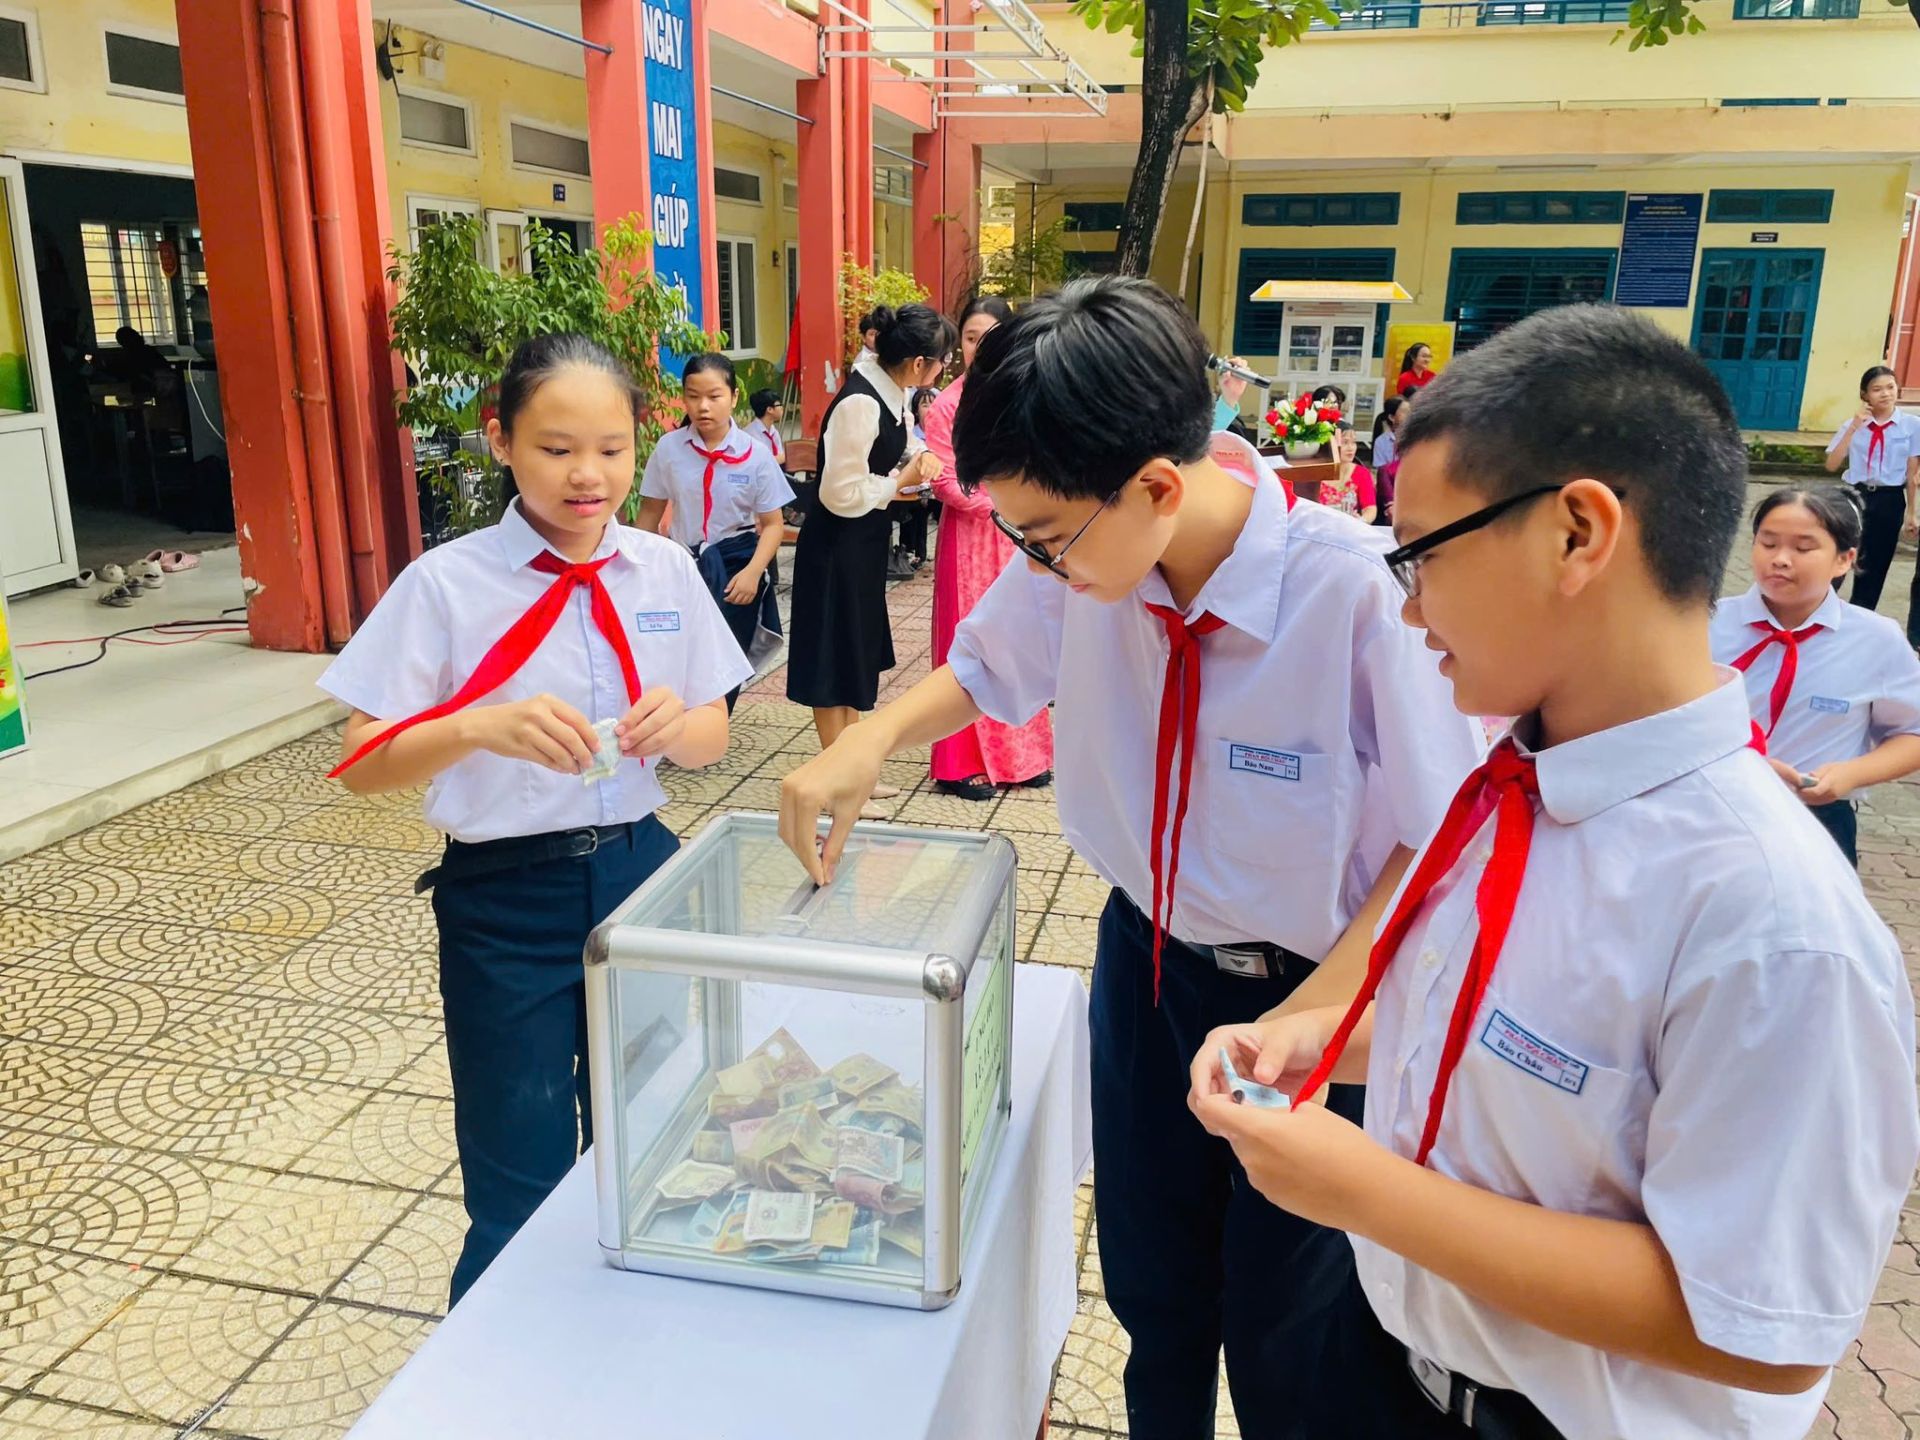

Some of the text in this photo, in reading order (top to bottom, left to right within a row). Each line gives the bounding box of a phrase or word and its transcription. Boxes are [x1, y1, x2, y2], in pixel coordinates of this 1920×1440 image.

[642, 0, 683, 70] NGÀY
[652, 101, 682, 160] MAI
[654, 183, 689, 248] GIÚP
[1258, 762, 1274, 771] Nam
[1516, 1052, 1544, 1072] Châu
